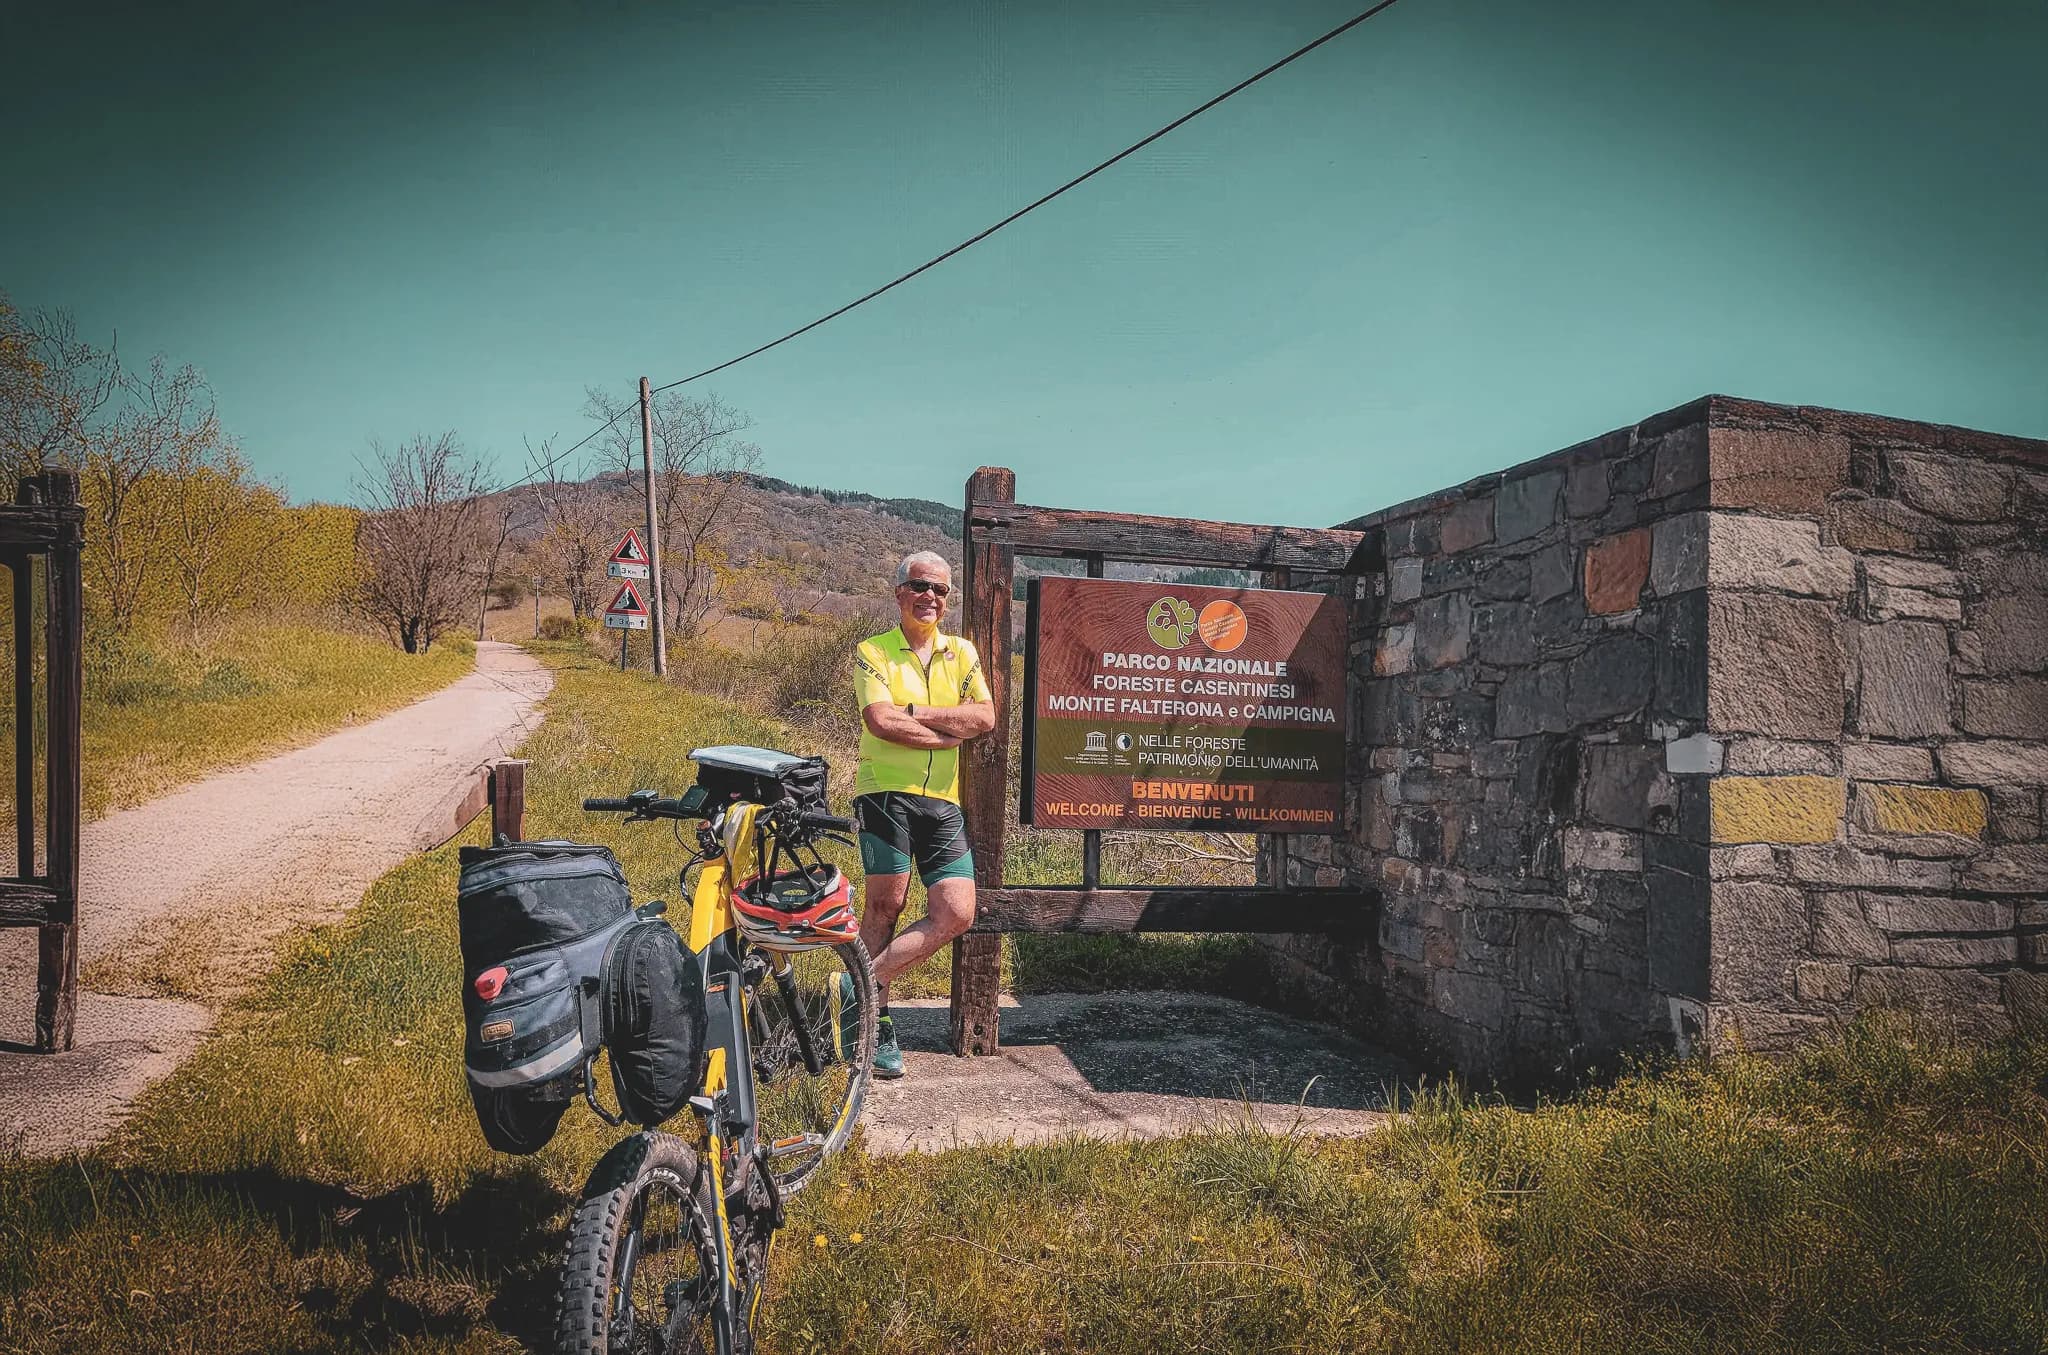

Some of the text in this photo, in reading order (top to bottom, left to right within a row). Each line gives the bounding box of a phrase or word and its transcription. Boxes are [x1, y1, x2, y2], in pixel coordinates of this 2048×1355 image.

[1103, 652, 1288, 677] PARCO NAZIONALE
[1093, 674, 1295, 699] FORESTE CASENTINESI
[1049, 695, 1336, 723] MONTE FALTERONA e CAMPIGNA
[1138, 734, 1247, 751] NELLE FORESTE
[1138, 752, 1222, 768] PATRIMONIO
[1225, 755, 1319, 771] DELL'UMANITÀ
[1132, 781, 1255, 802] BENVENUTI
[1045, 802, 1125, 817] WELCOME
[1138, 804, 1222, 820] BIENVENUE
[1234, 807, 1334, 823] WILLKOMMEN
